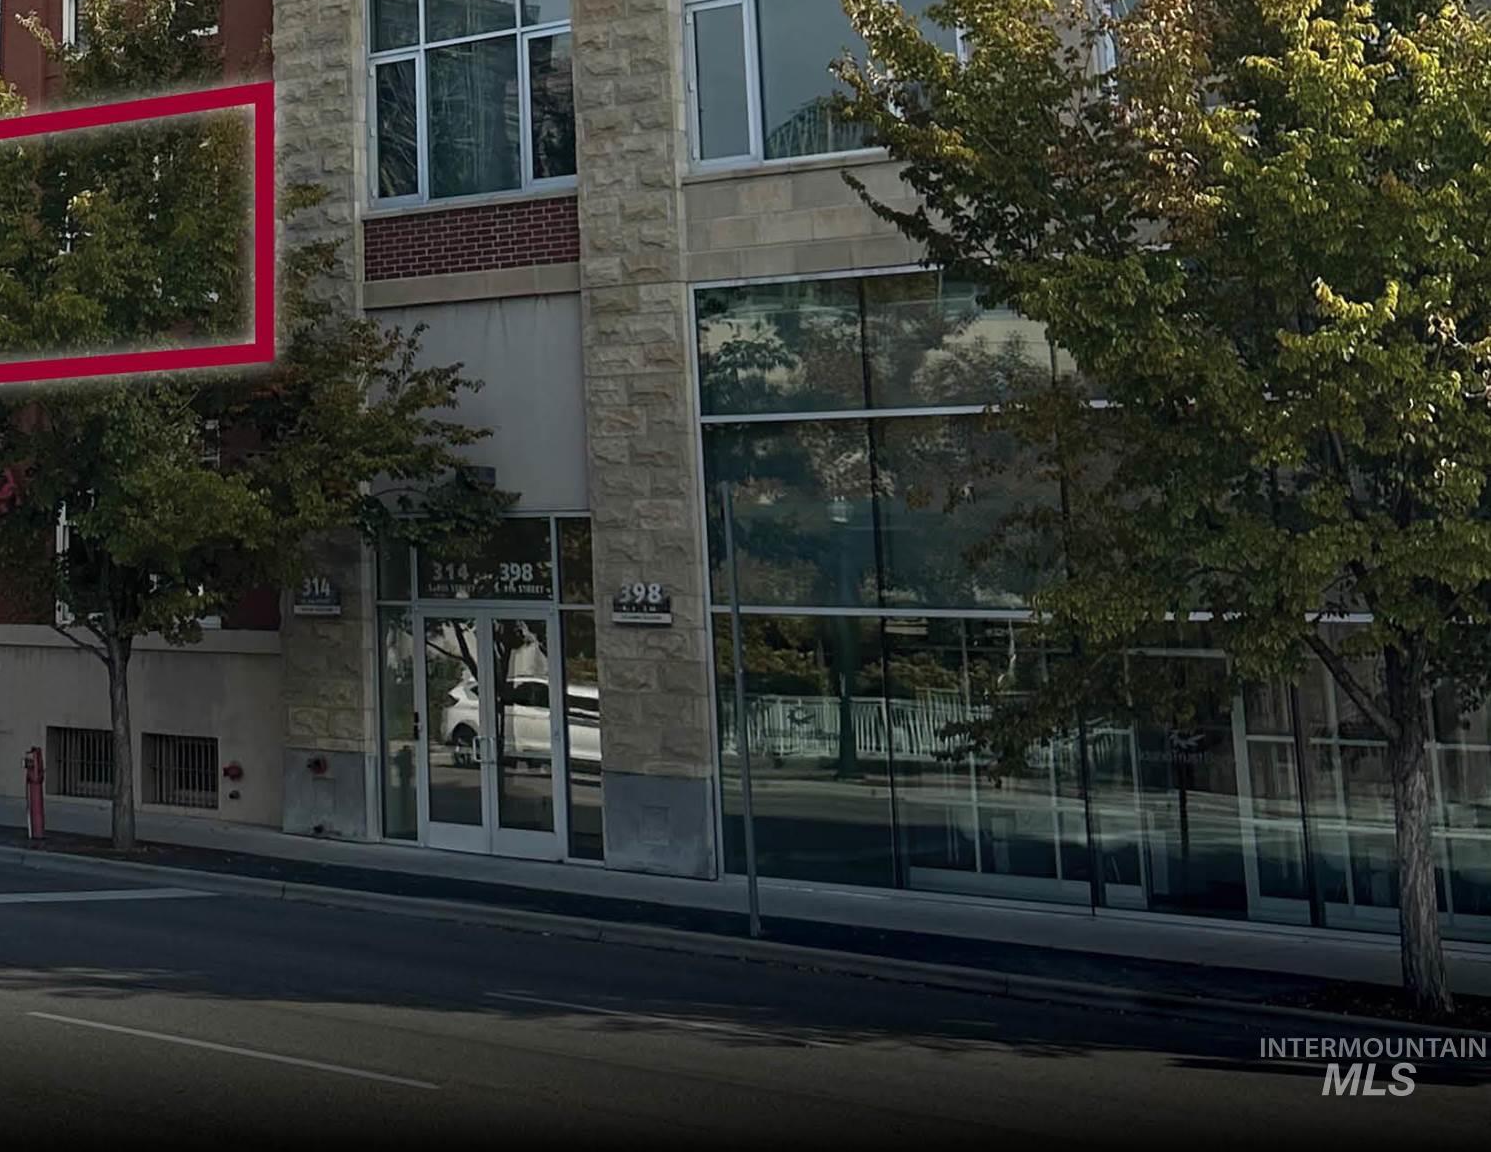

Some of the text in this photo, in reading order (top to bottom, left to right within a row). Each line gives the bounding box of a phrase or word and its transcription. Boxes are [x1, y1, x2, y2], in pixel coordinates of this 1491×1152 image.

[431, 559, 535, 583] 314 398
[301, 576, 331, 597] 314
[618, 582, 663, 604] 398
